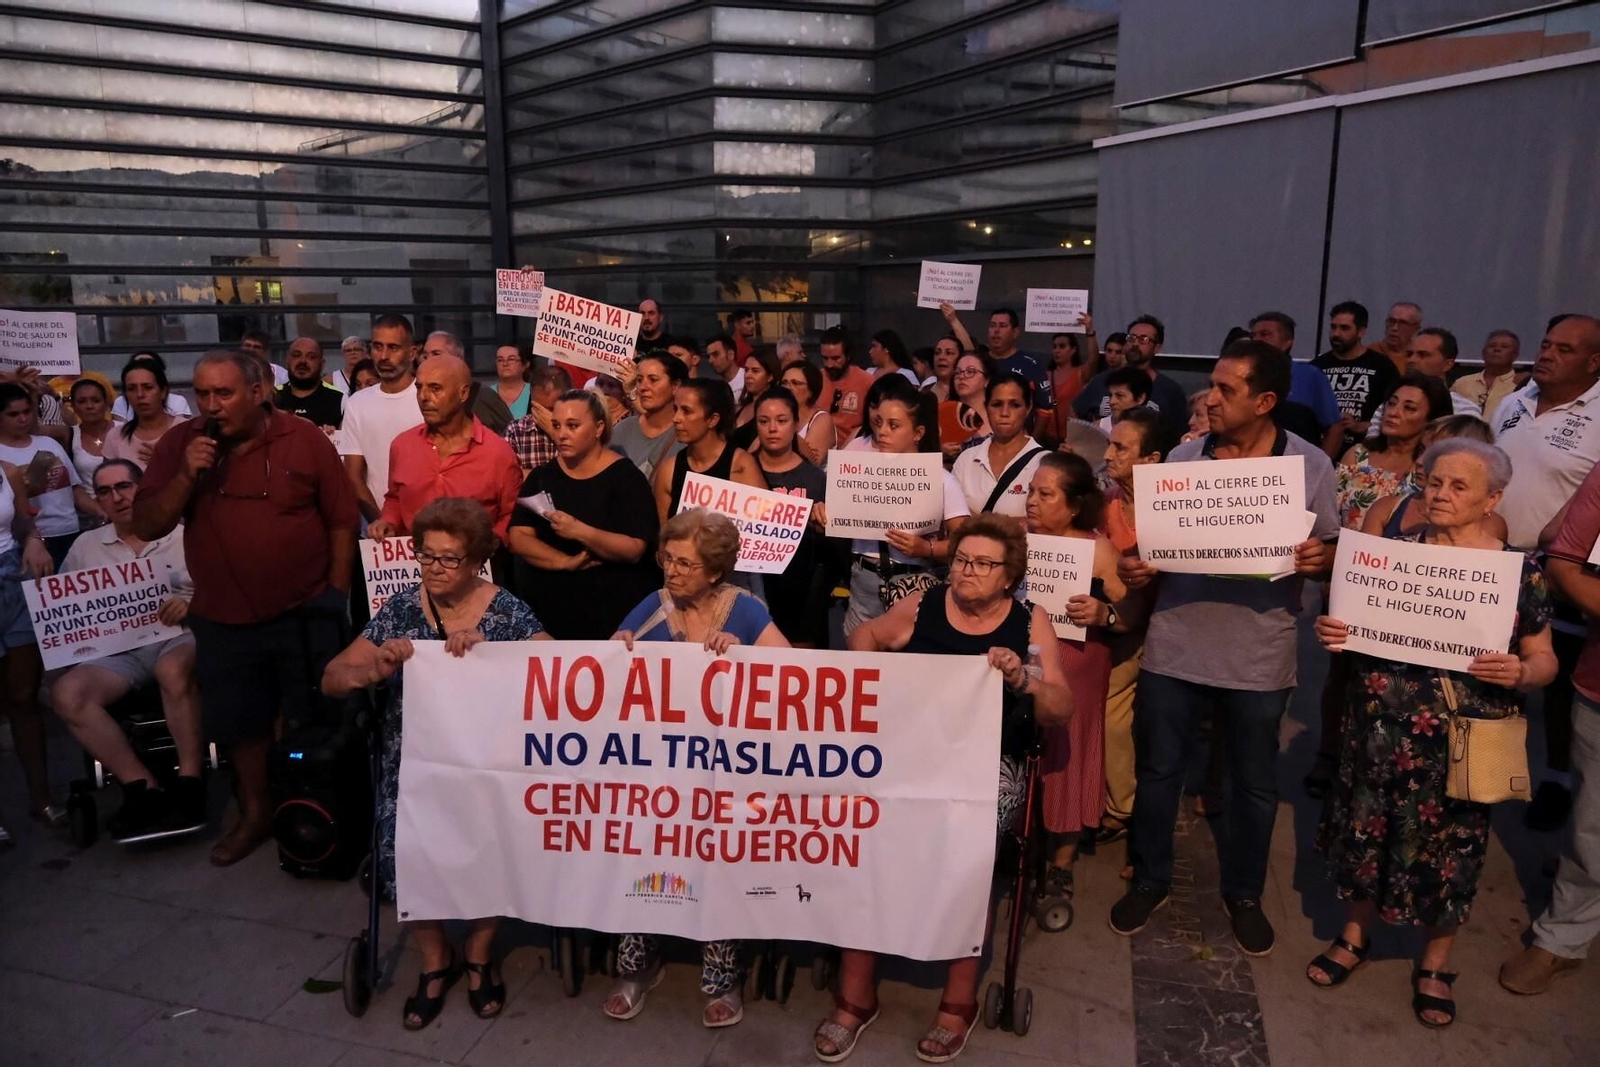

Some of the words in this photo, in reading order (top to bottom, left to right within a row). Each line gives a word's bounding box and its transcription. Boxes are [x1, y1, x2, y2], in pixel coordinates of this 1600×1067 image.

[498, 271, 525, 282] CENTRO
[511, 282, 519, 290] EL
[22, 321, 49, 329] CIERRE
[539, 312, 571, 328] JUNTA
[573, 322, 633, 346] ANDALUCÍA
[30, 331, 55, 339] SALUD
[537, 332, 550, 343] SE
[551, 336, 576, 351] RIEN
[1336, 392, 1361, 400] CIOSA
[840, 464, 861, 475] ¡No!
[864, 467, 874, 476] AL
[876, 467, 907, 476] CIERRE
[910, 468, 928, 477] DEL
[836, 479, 870, 490] CENTRO
[871, 482, 882, 490] DE
[885, 482, 915, 491] SALUD
[918, 482, 931, 491] EN
[1155, 477, 1190, 494] ¡No!
[1195, 479, 1211, 491] AL
[1214, 477, 1258, 489] CIERRE
[1262, 475, 1286, 487] DEL
[683, 480, 713, 508] NO
[715, 489, 738, 515] AL
[743, 495, 807, 528] CIERRE
[852, 494, 862, 503] EL
[863, 495, 912, 505] HIGUERON
[1152, 498, 1203, 511] CENTRO
[1207, 497, 1223, 509] DE
[1227, 495, 1269, 508] SALUD
[1273, 494, 1290, 506] EN
[852, 519, 863, 528] TUS
[864, 520, 896, 530] DERECHOS
[1178, 516, 1192, 527] EL
[1196, 513, 1264, 527] HIGUERON
[382, 540, 417, 562] BAS
[753, 540, 796, 554] SALUD
[1178, 549, 1195, 559] TUS
[1196, 548, 1242, 559] DERECHOS
[1027, 550, 1054, 562] ERRE
[1056, 553, 1077, 564] DEL
[367, 568, 410, 582] JUNTA
[1352, 551, 1388, 570] ¡No!
[1393, 561, 1410, 574] AL
[1415, 564, 1466, 581] CIERRE
[1471, 570, 1498, 584] DEL
[1063, 570, 1078, 581] EN
[1019, 581, 1055, 593] UERON
[1345, 571, 1398, 591] CENTRO
[1402, 582, 1421, 596] DE
[1426, 586, 1475, 603] SALUD
[1480, 592, 1500, 605] EN
[34, 603, 82, 623] JUNTA
[86, 584, 169, 611] ANDALUCÍA
[1367, 595, 1381, 608] EL
[1386, 599, 1466, 621] HIGUERON
[42, 637, 61, 650] SE
[64, 627, 100, 645] RIEN
[104, 628, 118, 636] DEL
[120, 613, 158, 631] PUEB
[1361, 626, 1379, 641] TUS
[1379, 631, 1432, 650] DERECHOS
[523, 655, 605, 722] NO
[619, 657, 686, 724] AL
[700, 660, 880, 733] CIERRE
[524, 732, 588, 766] NO
[599, 733, 652, 768] AL
[662, 734, 883, 778] TRASLADO
[523, 782, 681, 819] CENTRO
[691, 787, 733, 823] DE
[746, 791, 880, 830] SALUD
[543, 820, 591, 852] EN
[604, 820, 642, 855] EL
[654, 824, 859, 867] HIGUERÓN
